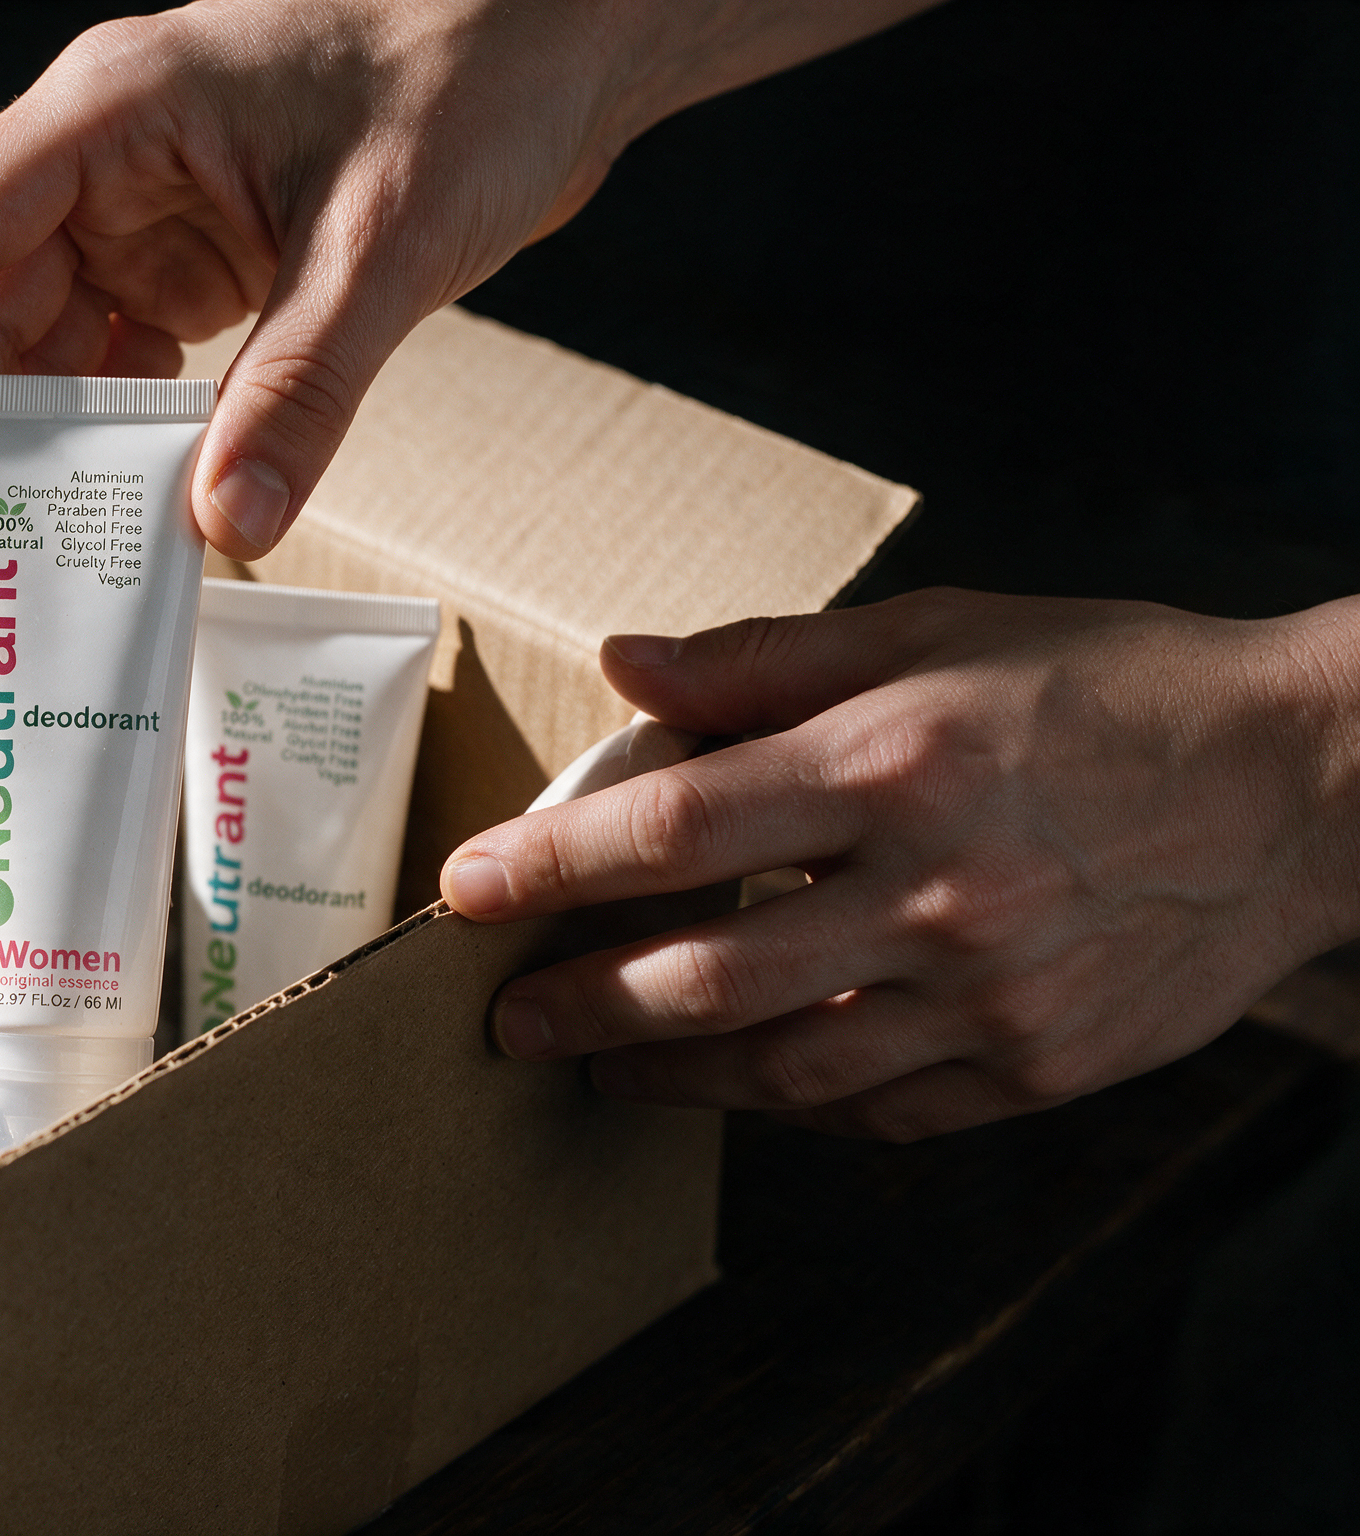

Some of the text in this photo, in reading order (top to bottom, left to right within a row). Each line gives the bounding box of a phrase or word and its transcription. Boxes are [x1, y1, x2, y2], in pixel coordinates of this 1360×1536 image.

[70, 470, 144, 484] Aluminium
[7, 485, 144, 503] Chlorchydrate Free
[47, 503, 143, 518] Paraben Free
[54, 520, 143, 535] Alcohol Free
[61, 537, 142, 554] Glycol Free
[55, 554, 142, 572] Cruelty Free
[97, 572, 141, 589] Vegan
[22, 704, 161, 733] deodorant
[246, 876, 367, 909] deodorant
[0, 973, 119, 991] original essence
[84, 995, 102, 1010] 66
